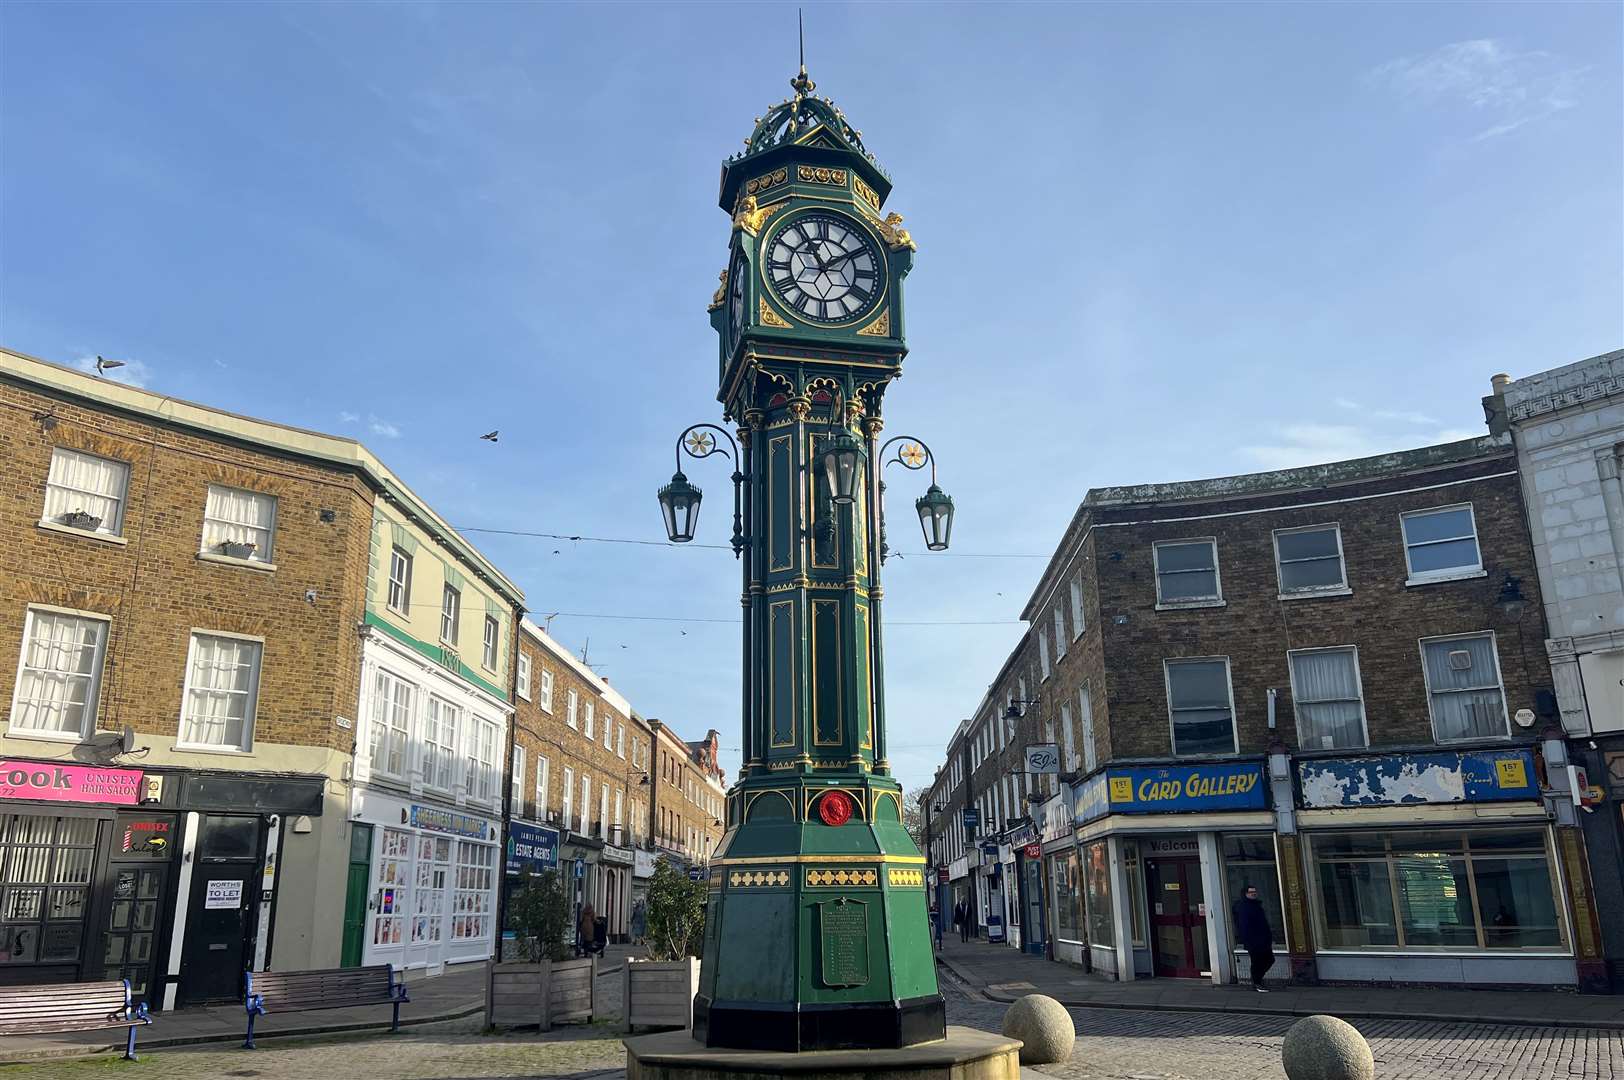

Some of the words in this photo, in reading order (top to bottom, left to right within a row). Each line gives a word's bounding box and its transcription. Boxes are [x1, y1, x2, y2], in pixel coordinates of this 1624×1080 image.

[0, 767, 73, 790] ook
[86, 773, 137, 785] UNISEX
[81, 783, 105, 794] HAIR
[105, 785, 137, 797] SALON
[1138, 779, 1182, 801] CARD
[1185, 772, 1259, 798] GALLERY
[131, 821, 169, 833] UNISEX
[515, 843, 532, 858] ESTATE
[533, 846, 550, 861] AGENTS
[1150, 840, 1200, 851] Welcom
